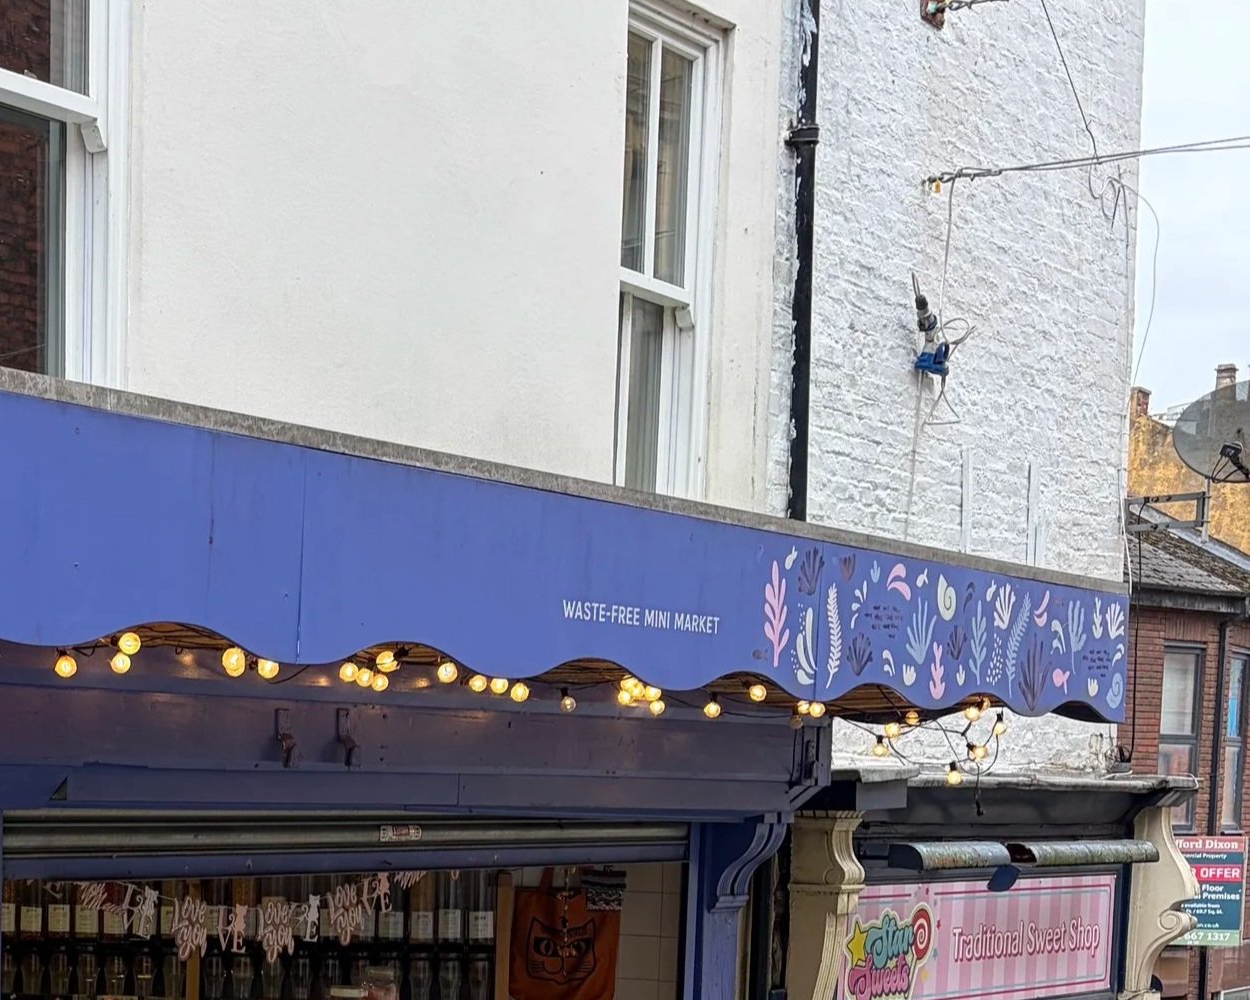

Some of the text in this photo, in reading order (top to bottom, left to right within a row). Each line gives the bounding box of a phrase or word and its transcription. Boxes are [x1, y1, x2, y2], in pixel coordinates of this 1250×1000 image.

[562, 599, 720, 635] WASTE-FREE MINI MARKET
[1205, 839, 1239, 849] Dixon
[1200, 867, 1241, 879] OFFER
[1201, 884, 1224, 893] Floor
[1202, 892, 1240, 901] Premises
[865, 915, 915, 967] Star
[952, 919, 1101, 963] Traditional Sweet Shop
[1207, 932, 1231, 941] 1317
